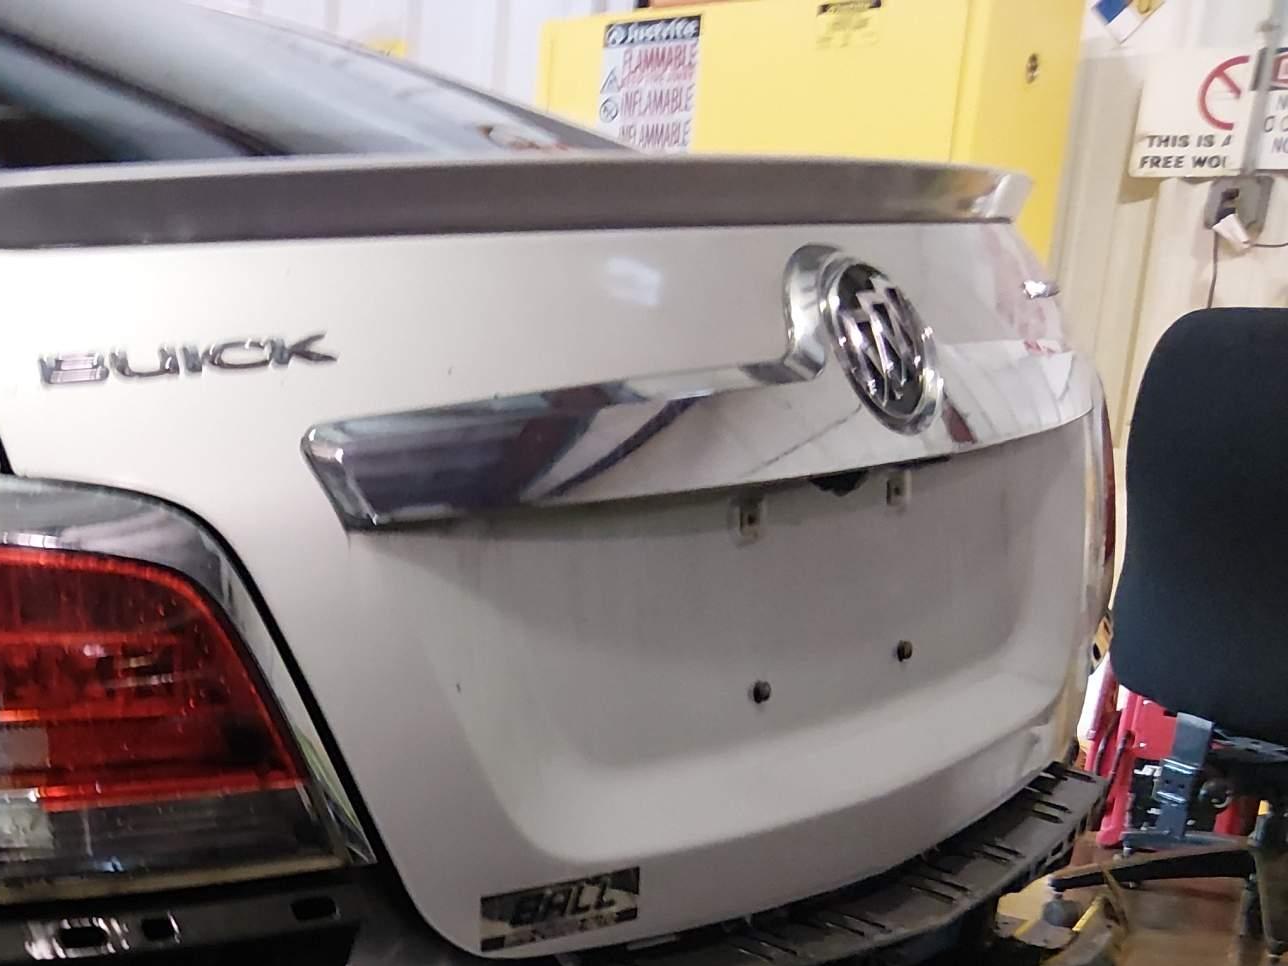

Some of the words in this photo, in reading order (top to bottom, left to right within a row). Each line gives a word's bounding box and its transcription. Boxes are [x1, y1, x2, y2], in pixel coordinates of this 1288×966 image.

[622, 43, 697, 75] FLAMMABLE
[1146, 134, 1190, 148] THIS
[1196, 134, 1215, 148] IS
[1139, 155, 1185, 168] FREE
[1192, 155, 1226, 168] WO
[39, 331, 338, 386] BUICK
